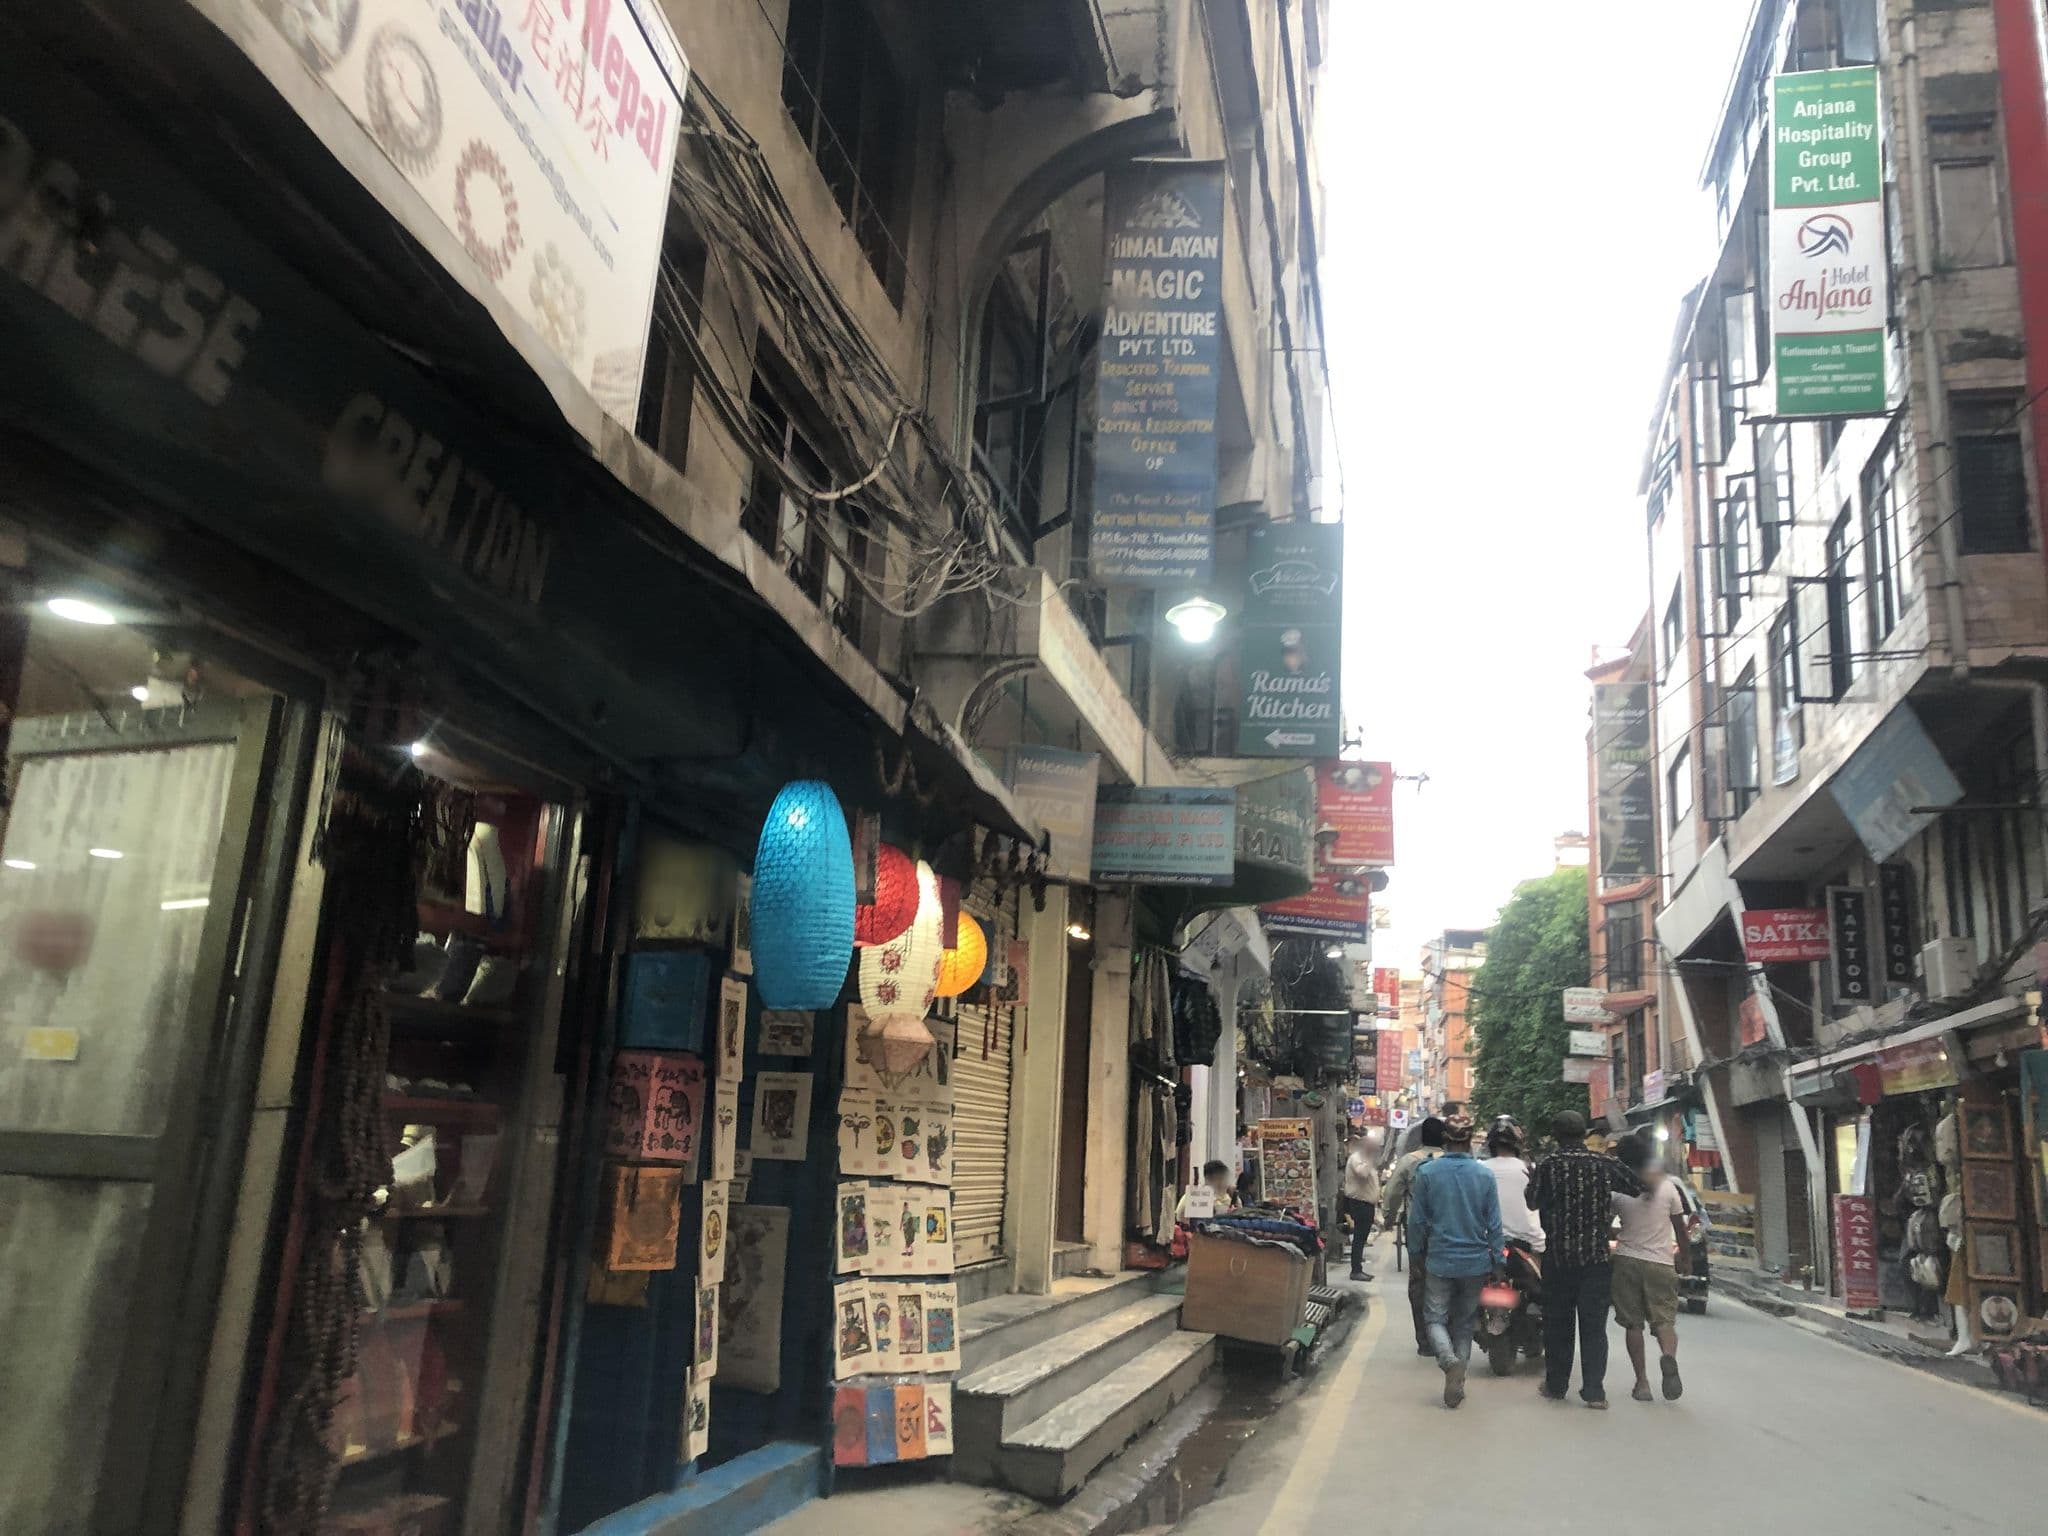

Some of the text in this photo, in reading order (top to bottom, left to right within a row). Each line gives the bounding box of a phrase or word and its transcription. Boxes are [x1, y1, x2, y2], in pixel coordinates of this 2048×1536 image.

[1793, 99, 1856, 119] Anjana
[1778, 121, 1873, 146] Hospitality
[1799, 150, 1852, 169] Group
[1791, 172, 1861, 193] Pvt. Ltd.
[1112, 269, 1205, 300] MAGIC
[1831, 265, 1870, 287] Hotel
[1778, 268, 1873, 320] Anjana
[1103, 305, 1217, 337] ADVENTURE
[1251, 670, 1331, 694] Rama's
[1247, 695, 1332, 719] Kitchen
[1841, 897, 1862, 994] TATTOO
[1848, 1202, 1873, 1270] SATKAR
